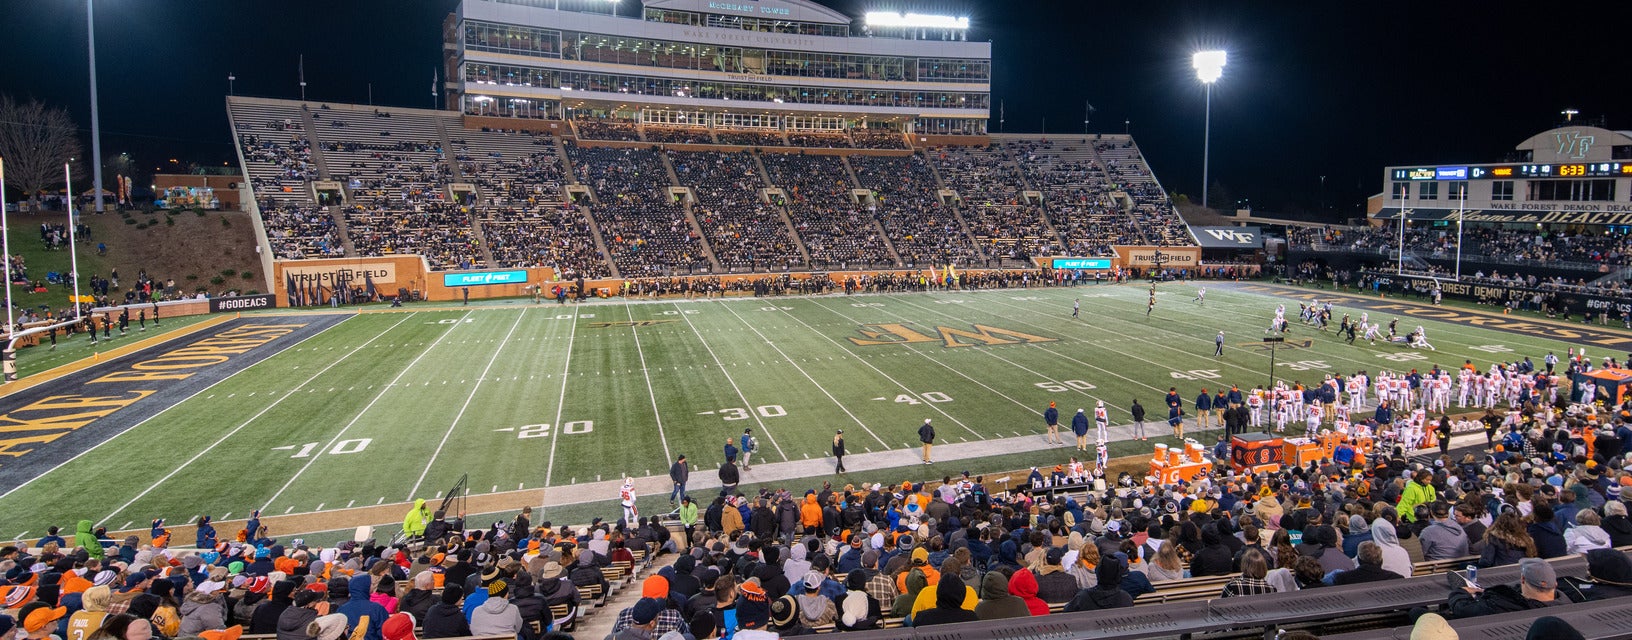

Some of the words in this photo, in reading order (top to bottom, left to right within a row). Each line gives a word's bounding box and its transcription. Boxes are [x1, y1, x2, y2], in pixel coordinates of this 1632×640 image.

[760, 6, 790, 15] TOWER
[683, 30, 711, 39] WAKE
[715, 33, 751, 43] FOREST
[756, 35, 815, 46] UNIVERSITY
[1551, 130, 1595, 159] WF
[1560, 165, 1585, 176] 6:33
[1521, 203, 1558, 211] FOREST
[1204, 229, 1254, 244] WF
[356, 269, 388, 279] FIELD
[463, 274, 486, 282] FLEET
[493, 273, 511, 281] FEET
[218, 297, 268, 310] #GODEACS
[1170, 369, 1222, 381] 40
[0, 390, 158, 461] AKE
[84, 323, 310, 385] FOREST
[1034, 379, 1097, 393] 50
[893, 391, 954, 406] 40
[719, 404, 788, 422] 30
[517, 420, 594, 439] 20
[290, 438, 373, 459] 10
[1260, 449, 1270, 463] S
[1154, 469, 1161, 479] G
[1170, 470, 1179, 483] G
[1200, 467, 1207, 477] S
